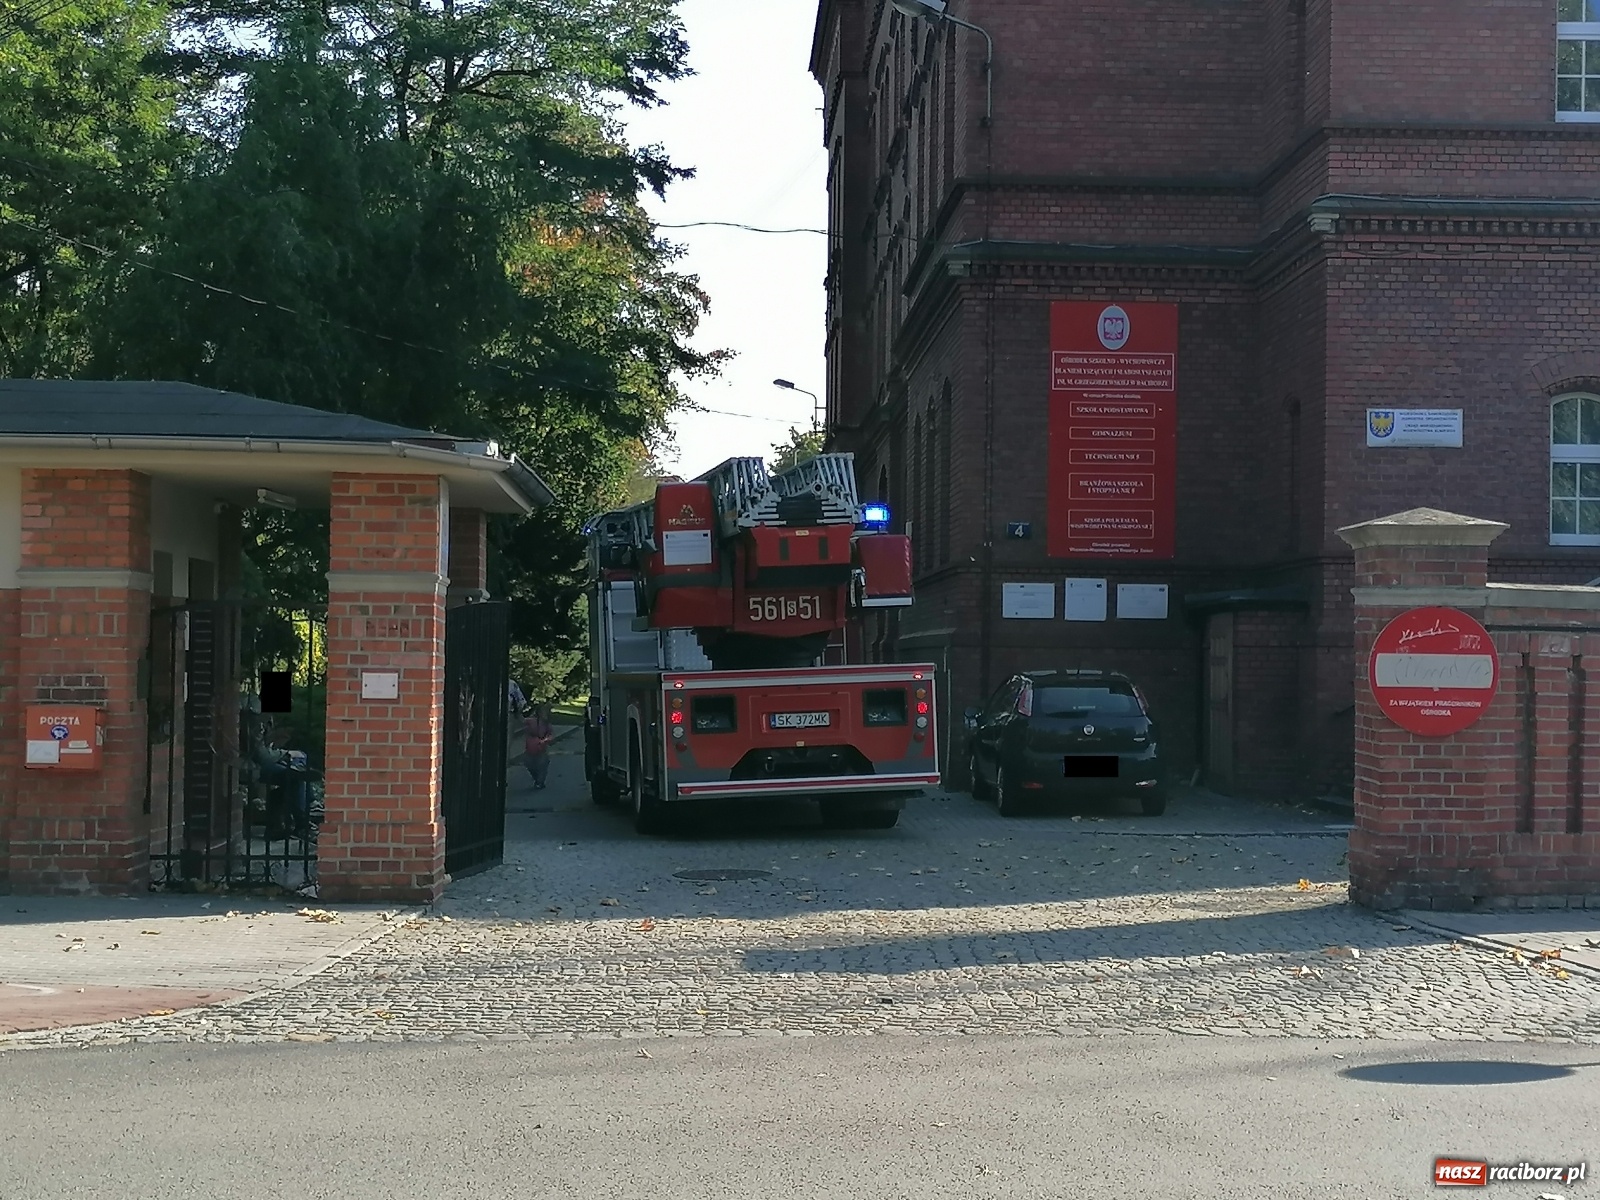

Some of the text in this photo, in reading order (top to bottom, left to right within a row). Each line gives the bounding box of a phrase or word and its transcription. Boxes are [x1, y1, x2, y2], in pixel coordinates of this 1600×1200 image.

[1015, 525, 1024, 537] 4
[40, 716, 80, 725] POCZTA
[778, 714, 827, 725] SK 372MK
